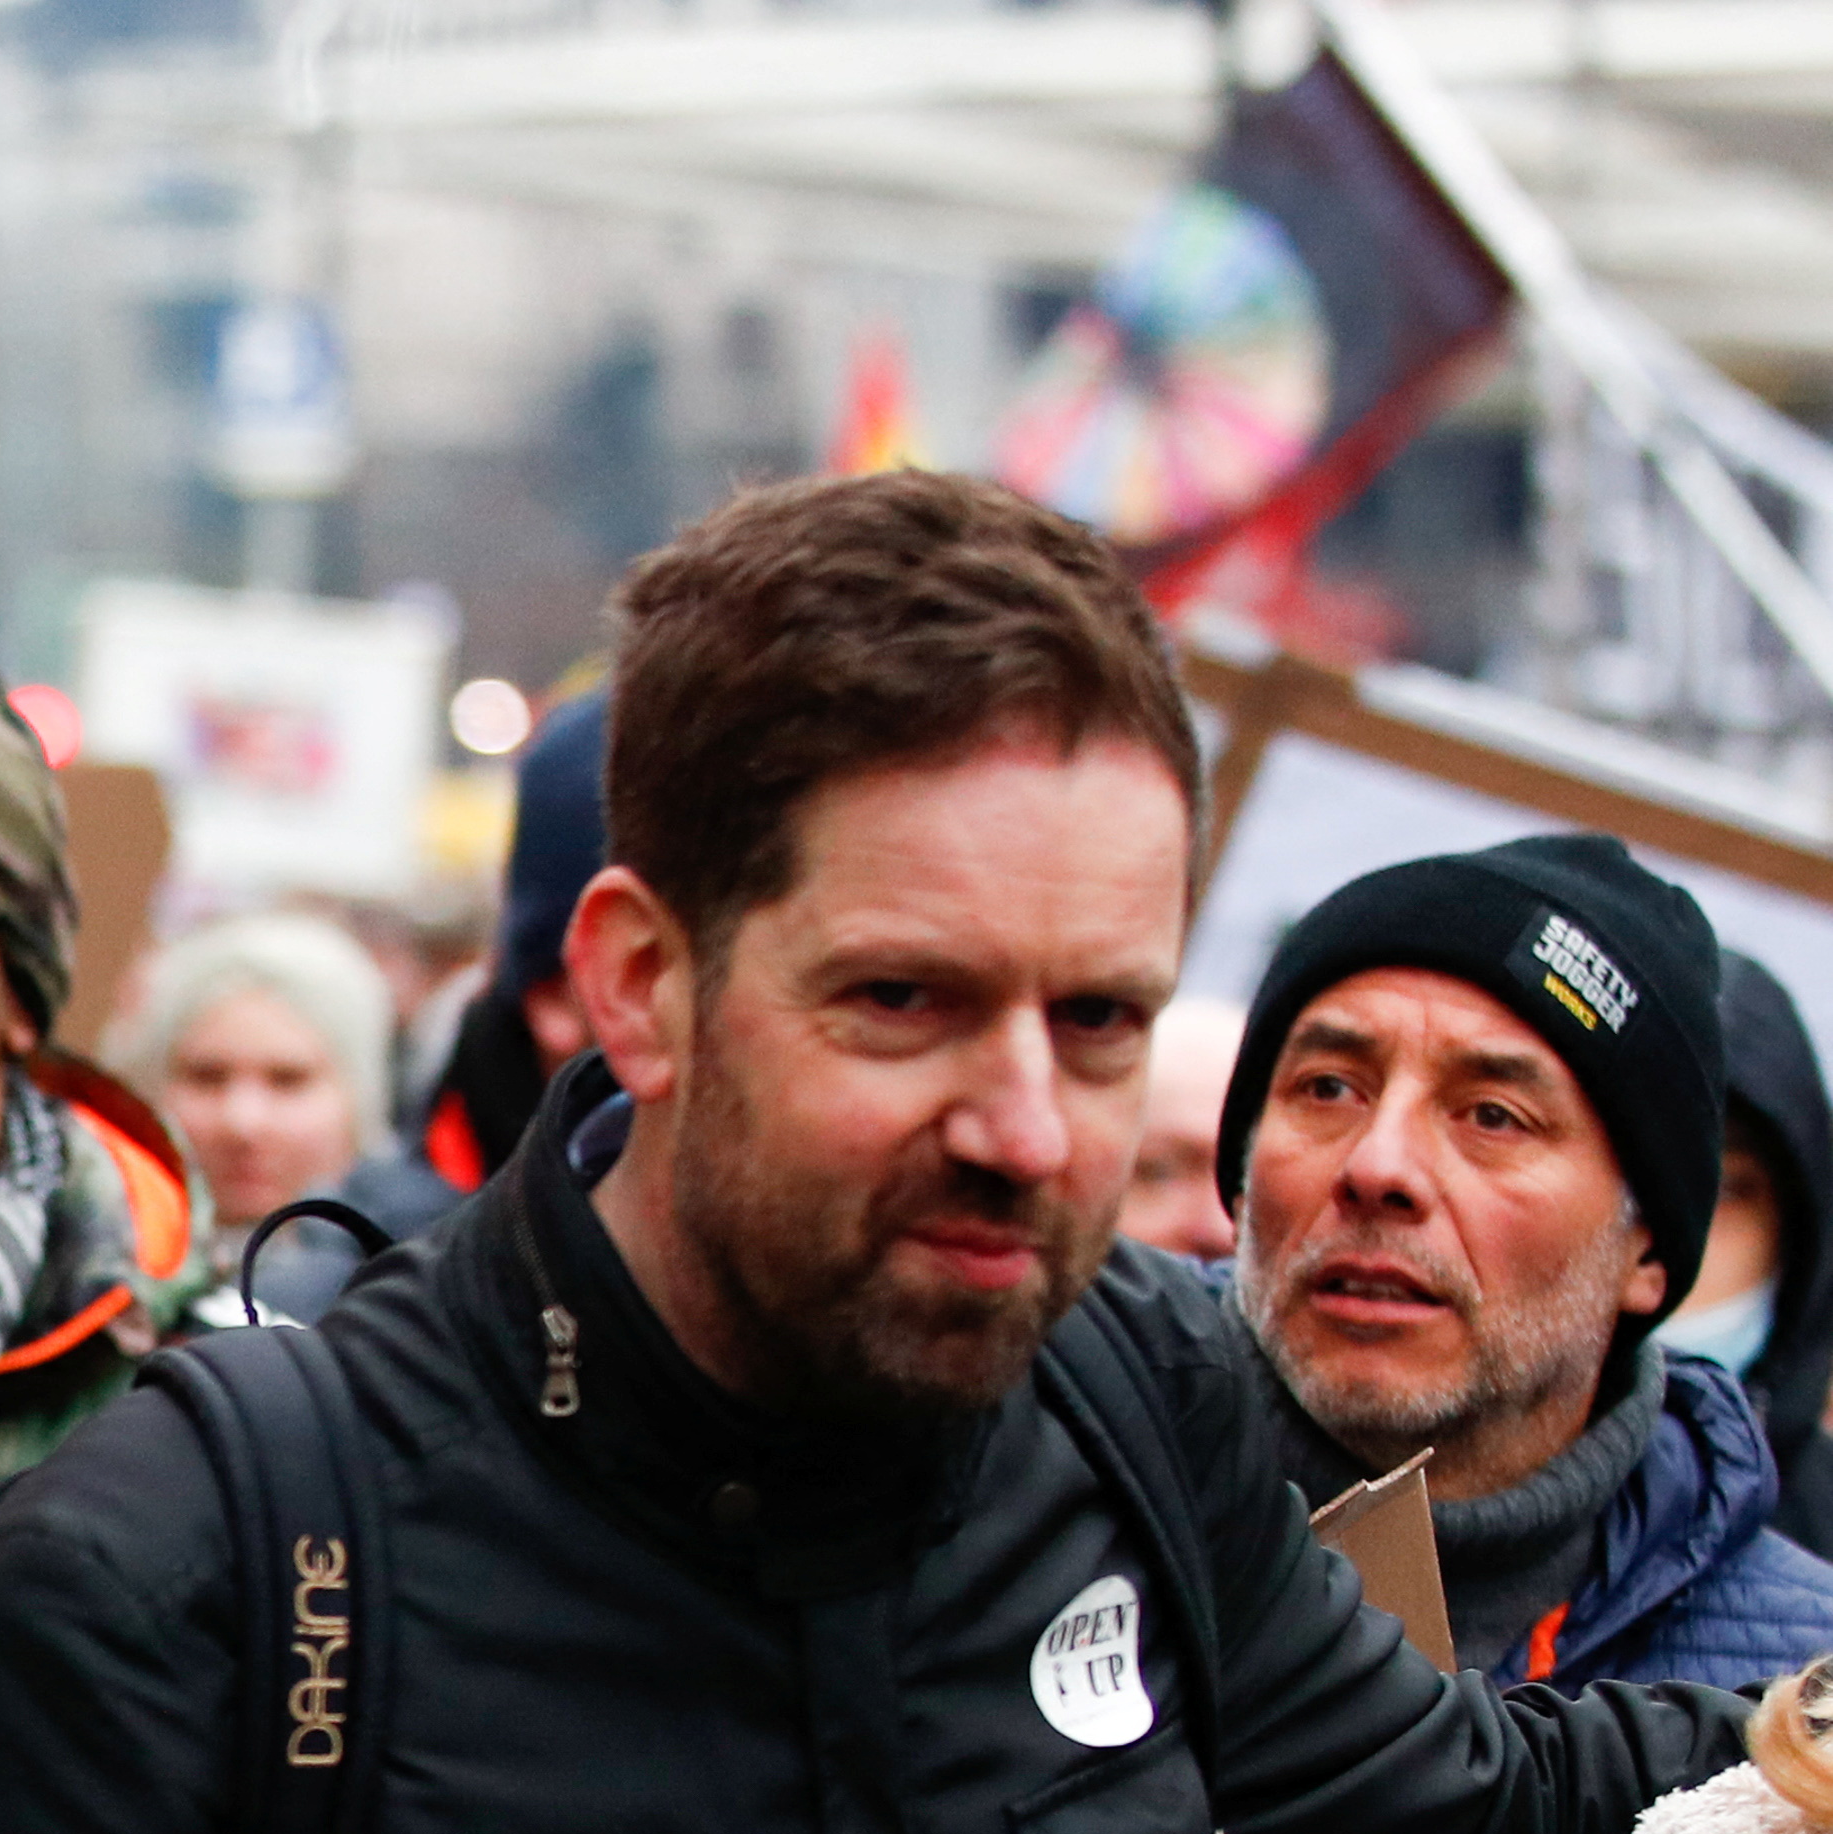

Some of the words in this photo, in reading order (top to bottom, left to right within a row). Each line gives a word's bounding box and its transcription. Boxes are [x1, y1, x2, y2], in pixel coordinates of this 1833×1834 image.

[1533, 934, 1626, 1034] JOGGER
[1544, 914, 1639, 1009] SAFETY
[287, 1533, 350, 1767] DAKINE
[1086, 1653, 1124, 1697] UP
